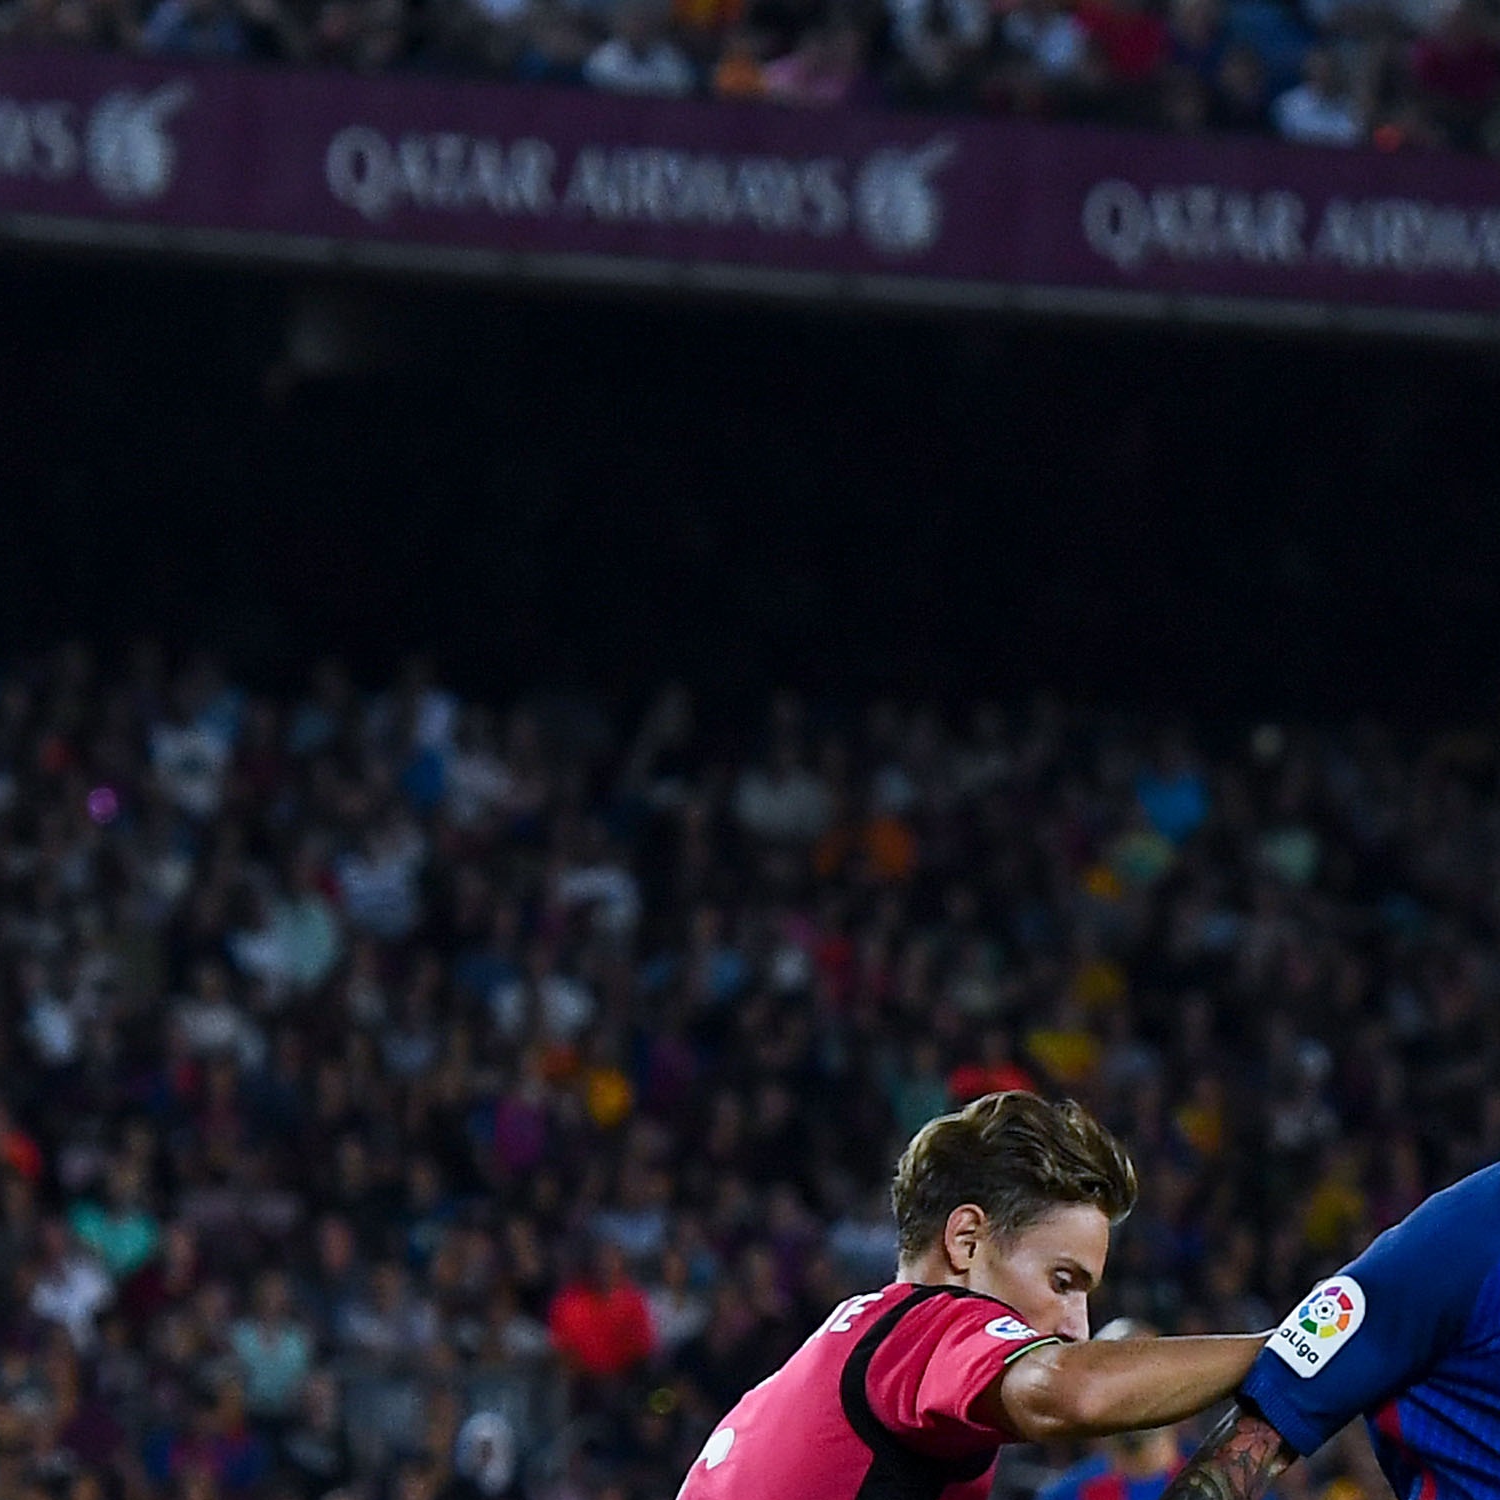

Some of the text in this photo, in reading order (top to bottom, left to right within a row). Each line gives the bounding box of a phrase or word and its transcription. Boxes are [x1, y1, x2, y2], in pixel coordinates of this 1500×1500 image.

[324, 124, 852, 238] QATAR AIRWAYS
[1080, 177, 1304, 271] QATAR
[1280, 1328, 1320, 1364] aLiga
